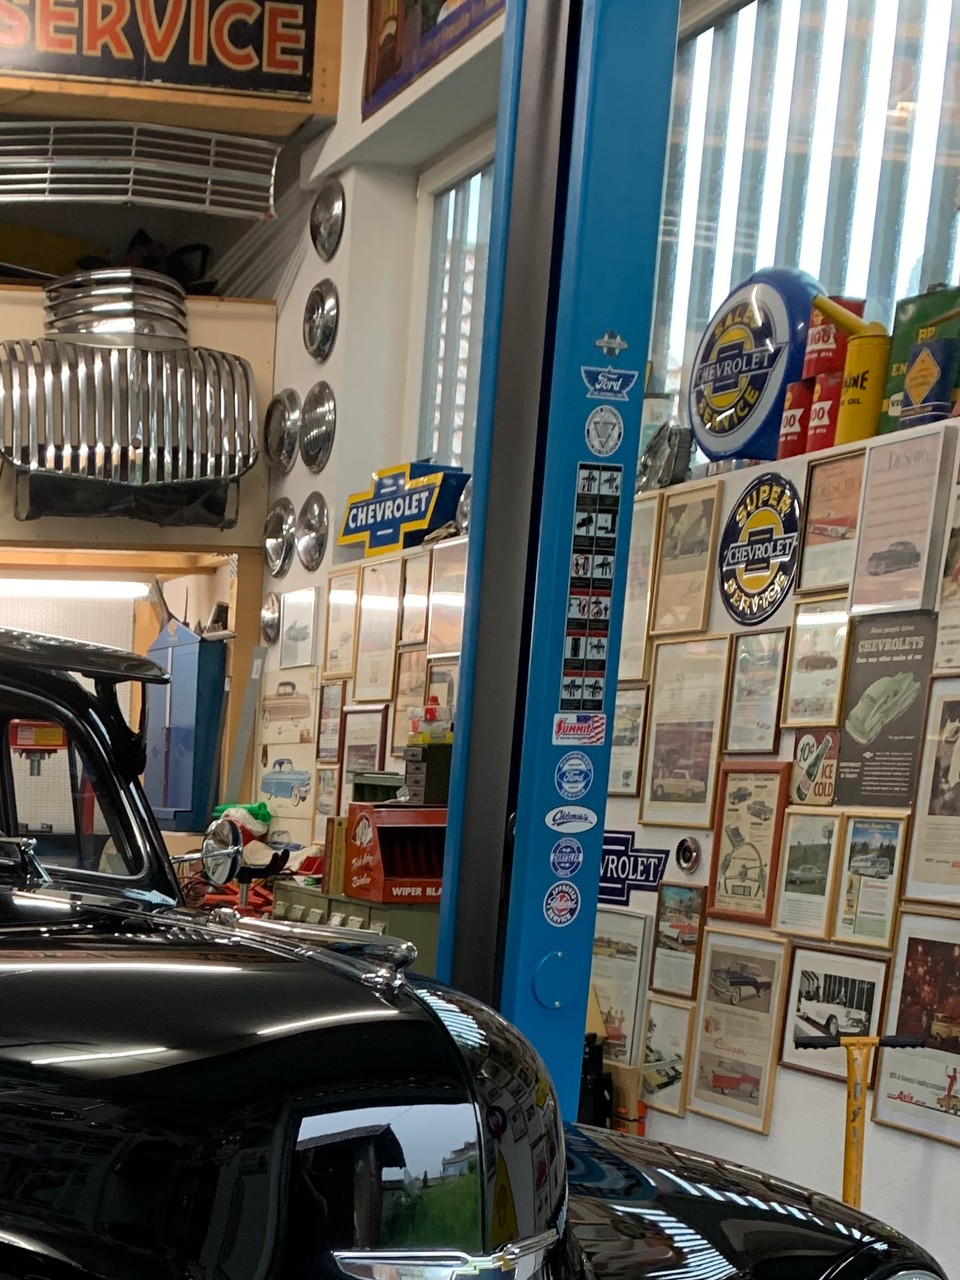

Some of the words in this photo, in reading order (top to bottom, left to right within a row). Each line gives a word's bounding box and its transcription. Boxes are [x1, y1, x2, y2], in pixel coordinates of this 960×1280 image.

[696, 351, 771, 384] CHEVROLET
[595, 372, 623, 391] Ford
[348, 490, 429, 529] CHEVROLET
[736, 483, 792, 528] SUPER
[729, 538, 794, 564] CHEVROLET
[724, 571, 789, 616] SERVICE
[858, 635, 925, 653] CHEVROLETS
[563, 769, 585, 783] Ford
[821, 763, 834, 780] ICE
[813, 781, 834, 798] COLD
[600, 855, 659, 881] VROLET
[391, 887, 423, 897] WIPER
[425, 887, 443, 896] BLA
